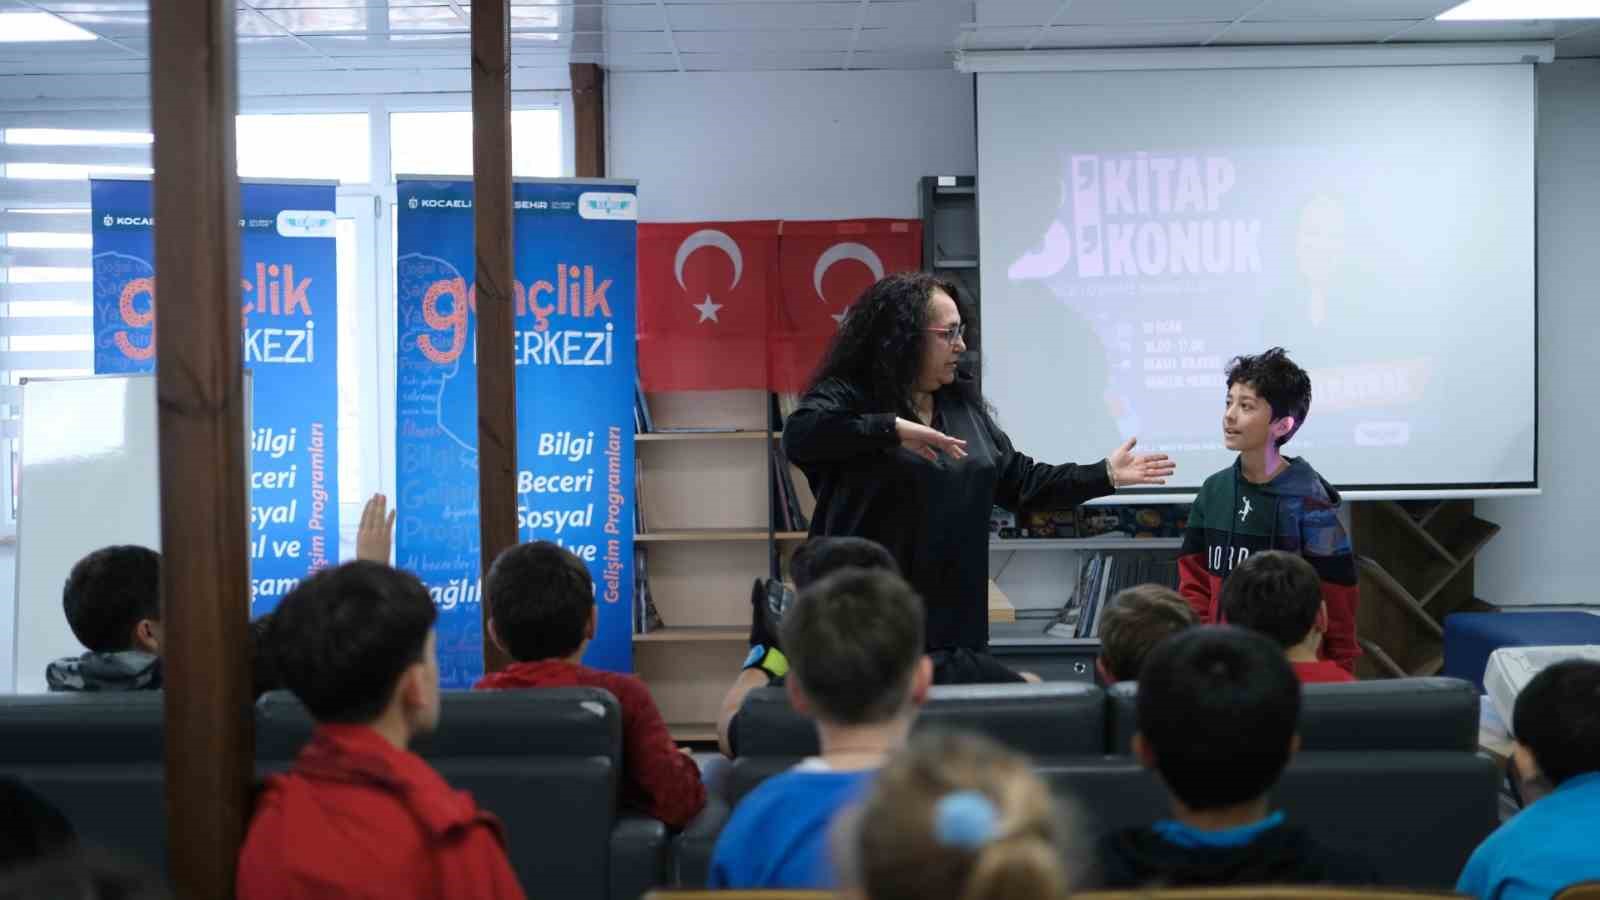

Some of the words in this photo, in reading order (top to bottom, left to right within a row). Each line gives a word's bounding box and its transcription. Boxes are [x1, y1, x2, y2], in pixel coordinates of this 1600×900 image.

[1104, 151, 1236, 214] KİTAP
[1107, 219, 1264, 275] KONUK
[244, 319, 315, 363] KEZİ
[537, 431, 595, 462] Bilgi
[251, 464, 298, 489] ceri
[517, 468, 595, 494] Beceri
[603, 426, 625, 534] Programları
[250, 499, 298, 530] syal
[517, 503, 594, 534] Sosyal
[272, 540, 302, 558] ve
[603, 539, 624, 603] Gelişim
